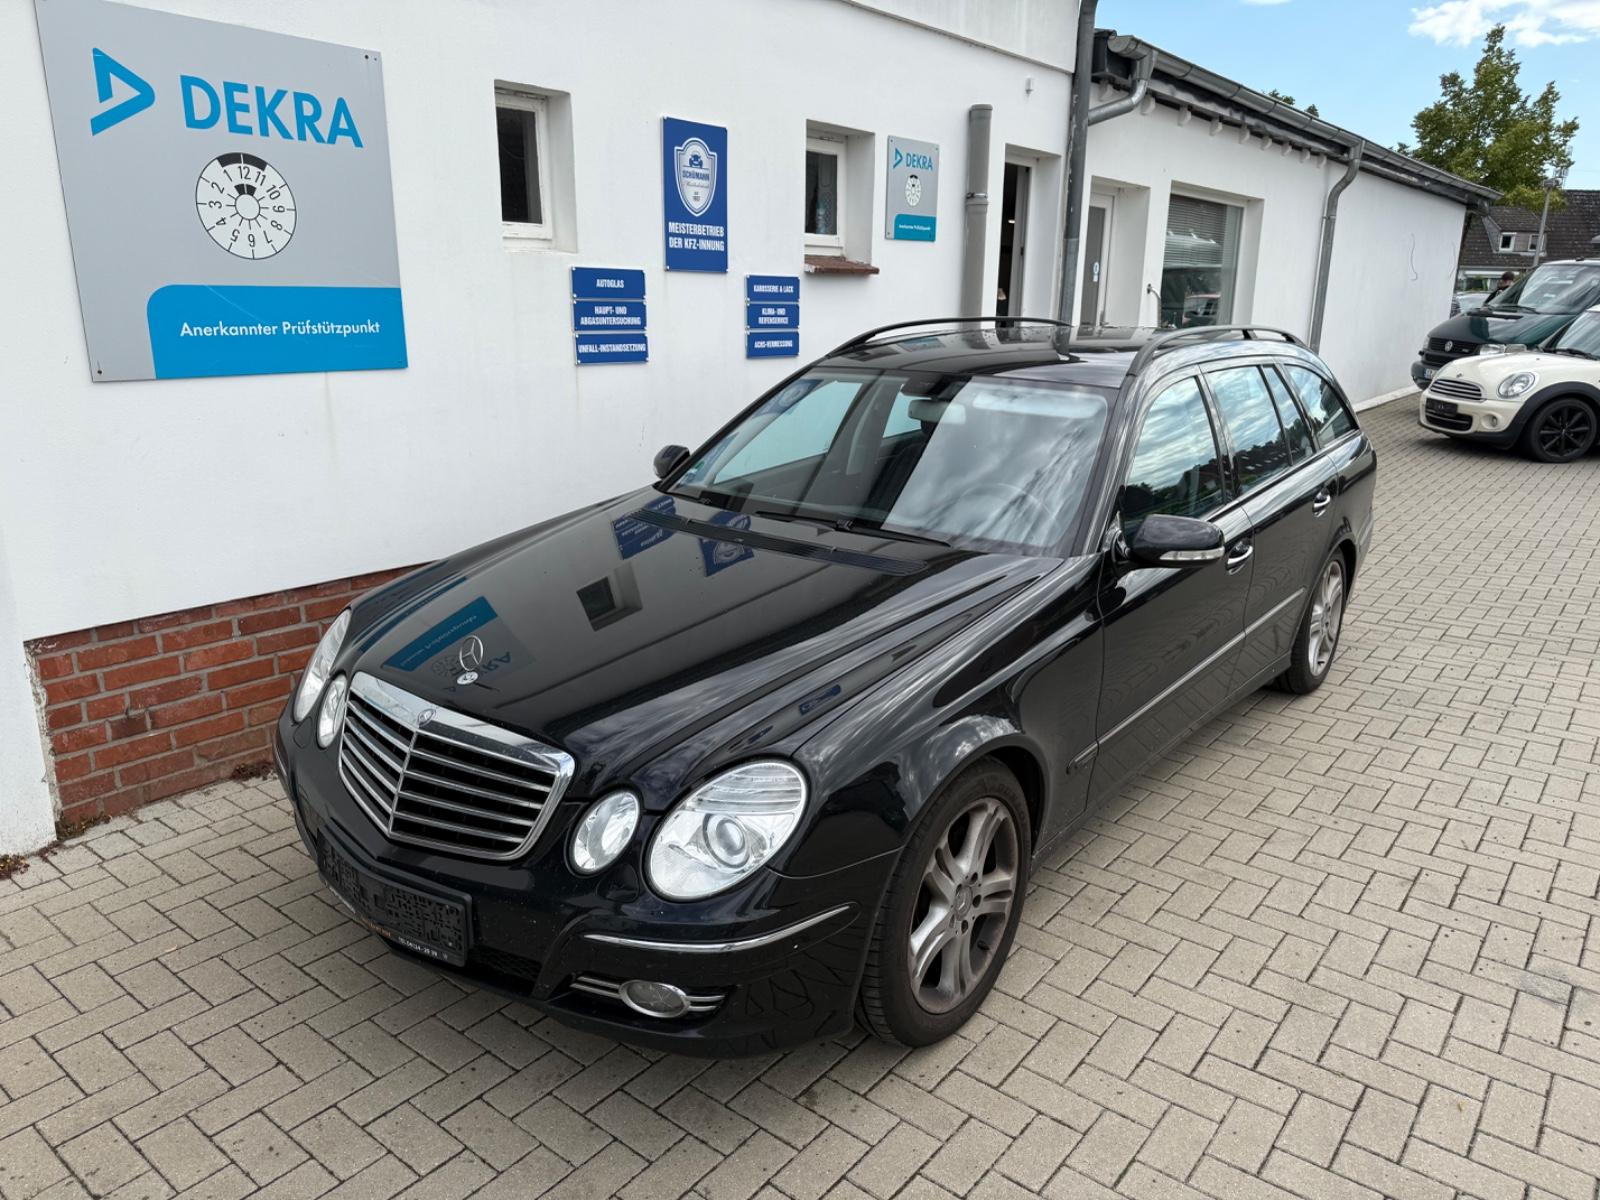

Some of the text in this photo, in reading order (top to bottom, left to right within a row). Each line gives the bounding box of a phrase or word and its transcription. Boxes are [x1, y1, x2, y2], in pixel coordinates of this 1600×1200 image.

[180, 74, 364, 148] DEKRA
[906, 153, 933, 170] DEKRA
[208, 165, 286, 248] 12 11 10 9 8 7 6 5 4 3 2 1
[668, 221, 725, 238] MEISTERBETRIEB
[668, 236, 725, 252] DER KFZ-INNUNG
[596, 279, 624, 288] AUTOGLAS
[594, 306, 627, 315] HAUPT- UND
[180, 319, 381, 338] Anerkannter Prüfstützpunkt
[580, 316, 642, 325] ABGASUNTERSUCHUNG
[578, 343, 646, 353] UNFALL-INSTANDSETZUNG
